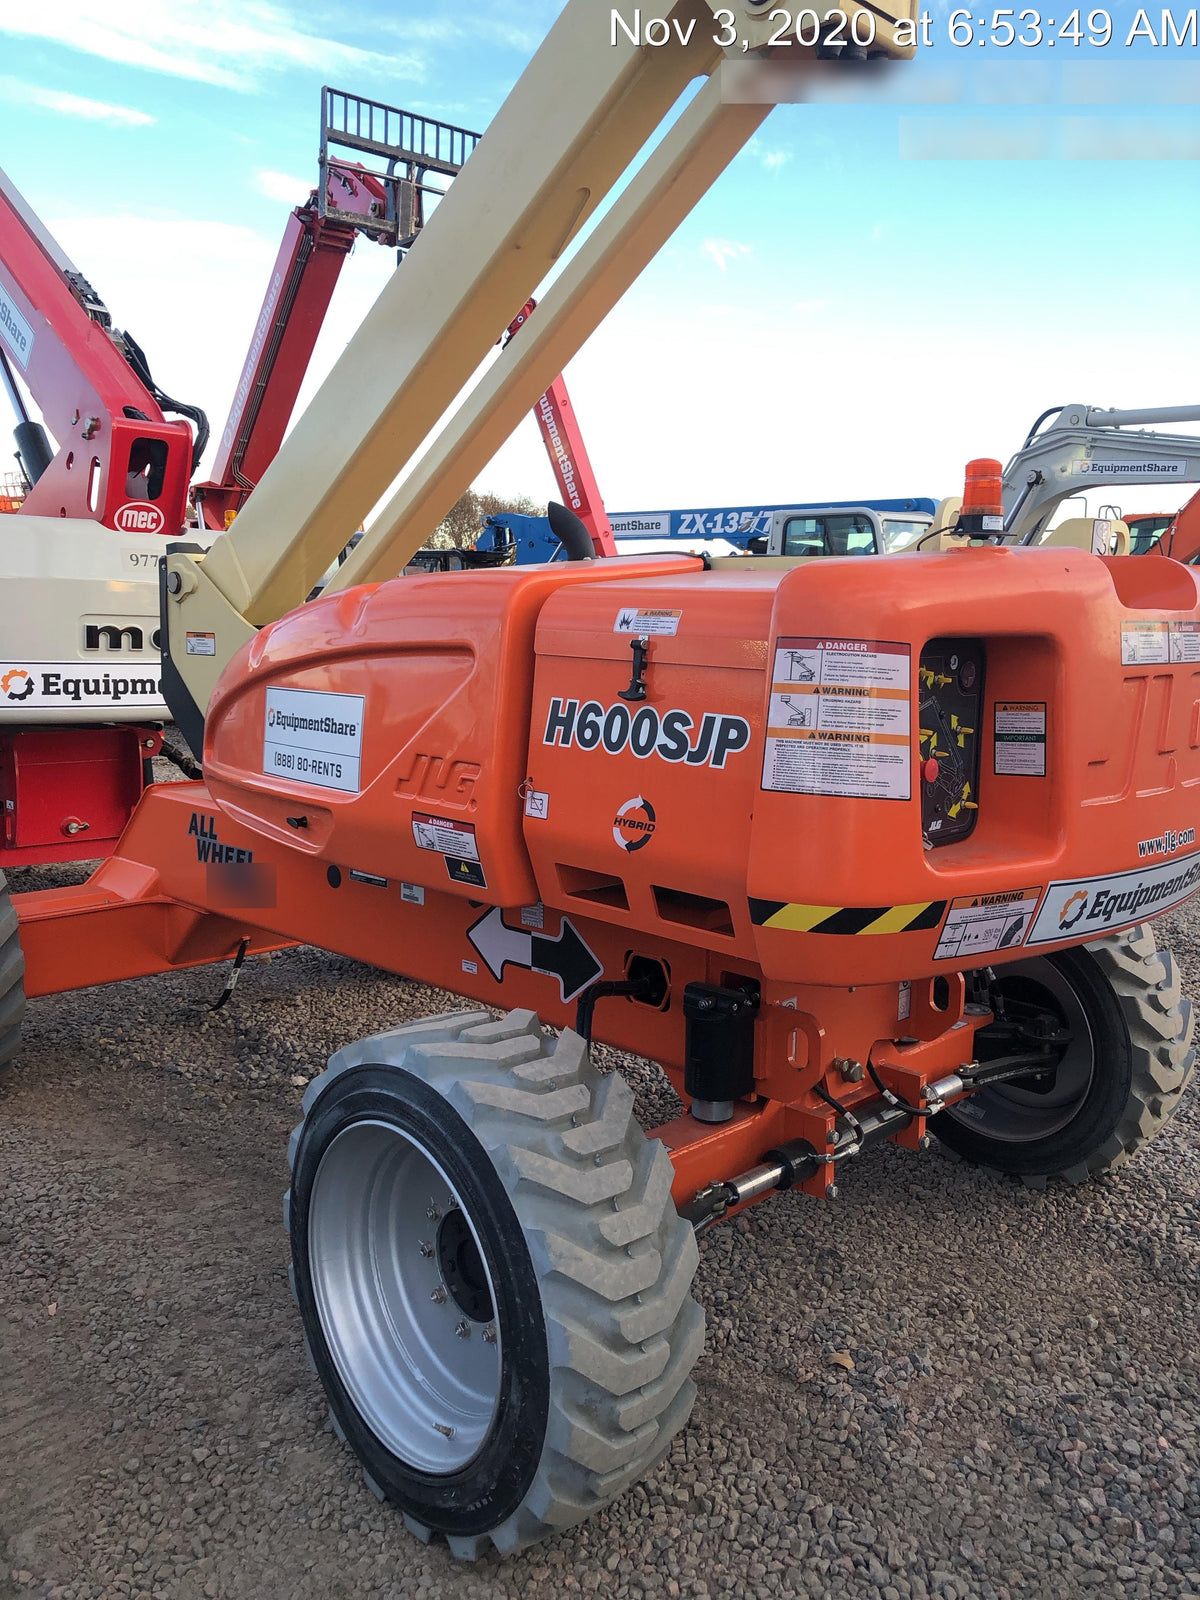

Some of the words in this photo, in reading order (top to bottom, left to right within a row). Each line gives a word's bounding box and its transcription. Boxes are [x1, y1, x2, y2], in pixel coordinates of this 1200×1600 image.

[0, 300, 27, 352] Share
[230, 272, 281, 428] EquipmentShare
[1091, 463, 1178, 474] EquipmentShare
[825, 641, 868, 652] DANGER
[822, 686, 870, 697] WARNING
[276, 710, 356, 736] EquipmentShare
[543, 697, 751, 769] H600SJP
[818, 732, 870, 743] WARNING
[274, 752, 295, 770] (888)
[297, 756, 342, 778] 80-RENTS
[393, 753, 481, 811] JLG
[188, 811, 218, 841] ALL
[433, 818, 454, 828] DANGER
[614, 816, 656, 833] HYBRID
[1138, 827, 1195, 857] www.jlg.com
[980, 892, 1024, 906] WARNING
